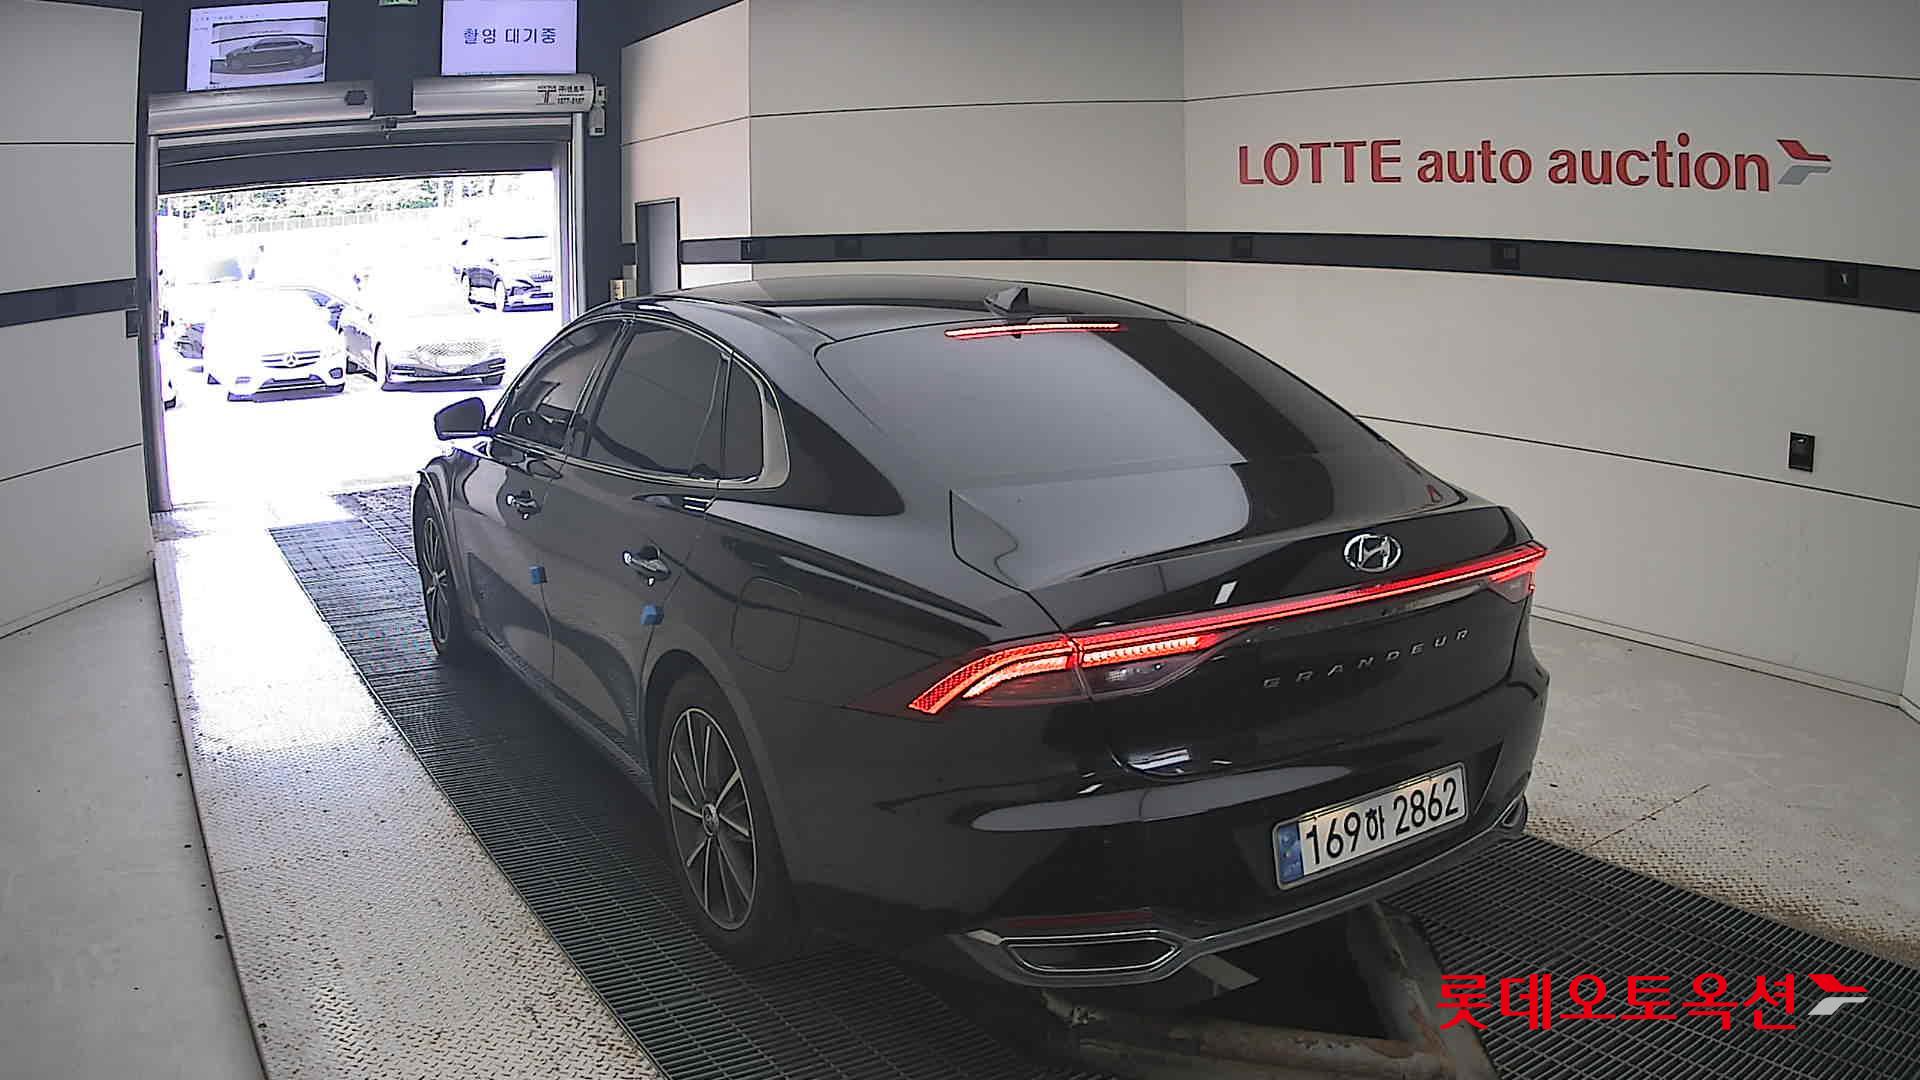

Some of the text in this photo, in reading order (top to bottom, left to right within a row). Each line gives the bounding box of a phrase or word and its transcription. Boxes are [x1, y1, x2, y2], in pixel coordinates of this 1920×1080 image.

[504, 27, 557, 45] 대기중
[1238, 132, 1771, 192] LOTTE auto auction
[1262, 628, 1469, 689] GRANDEUR
[1305, 776, 1460, 865] 169하 2862
